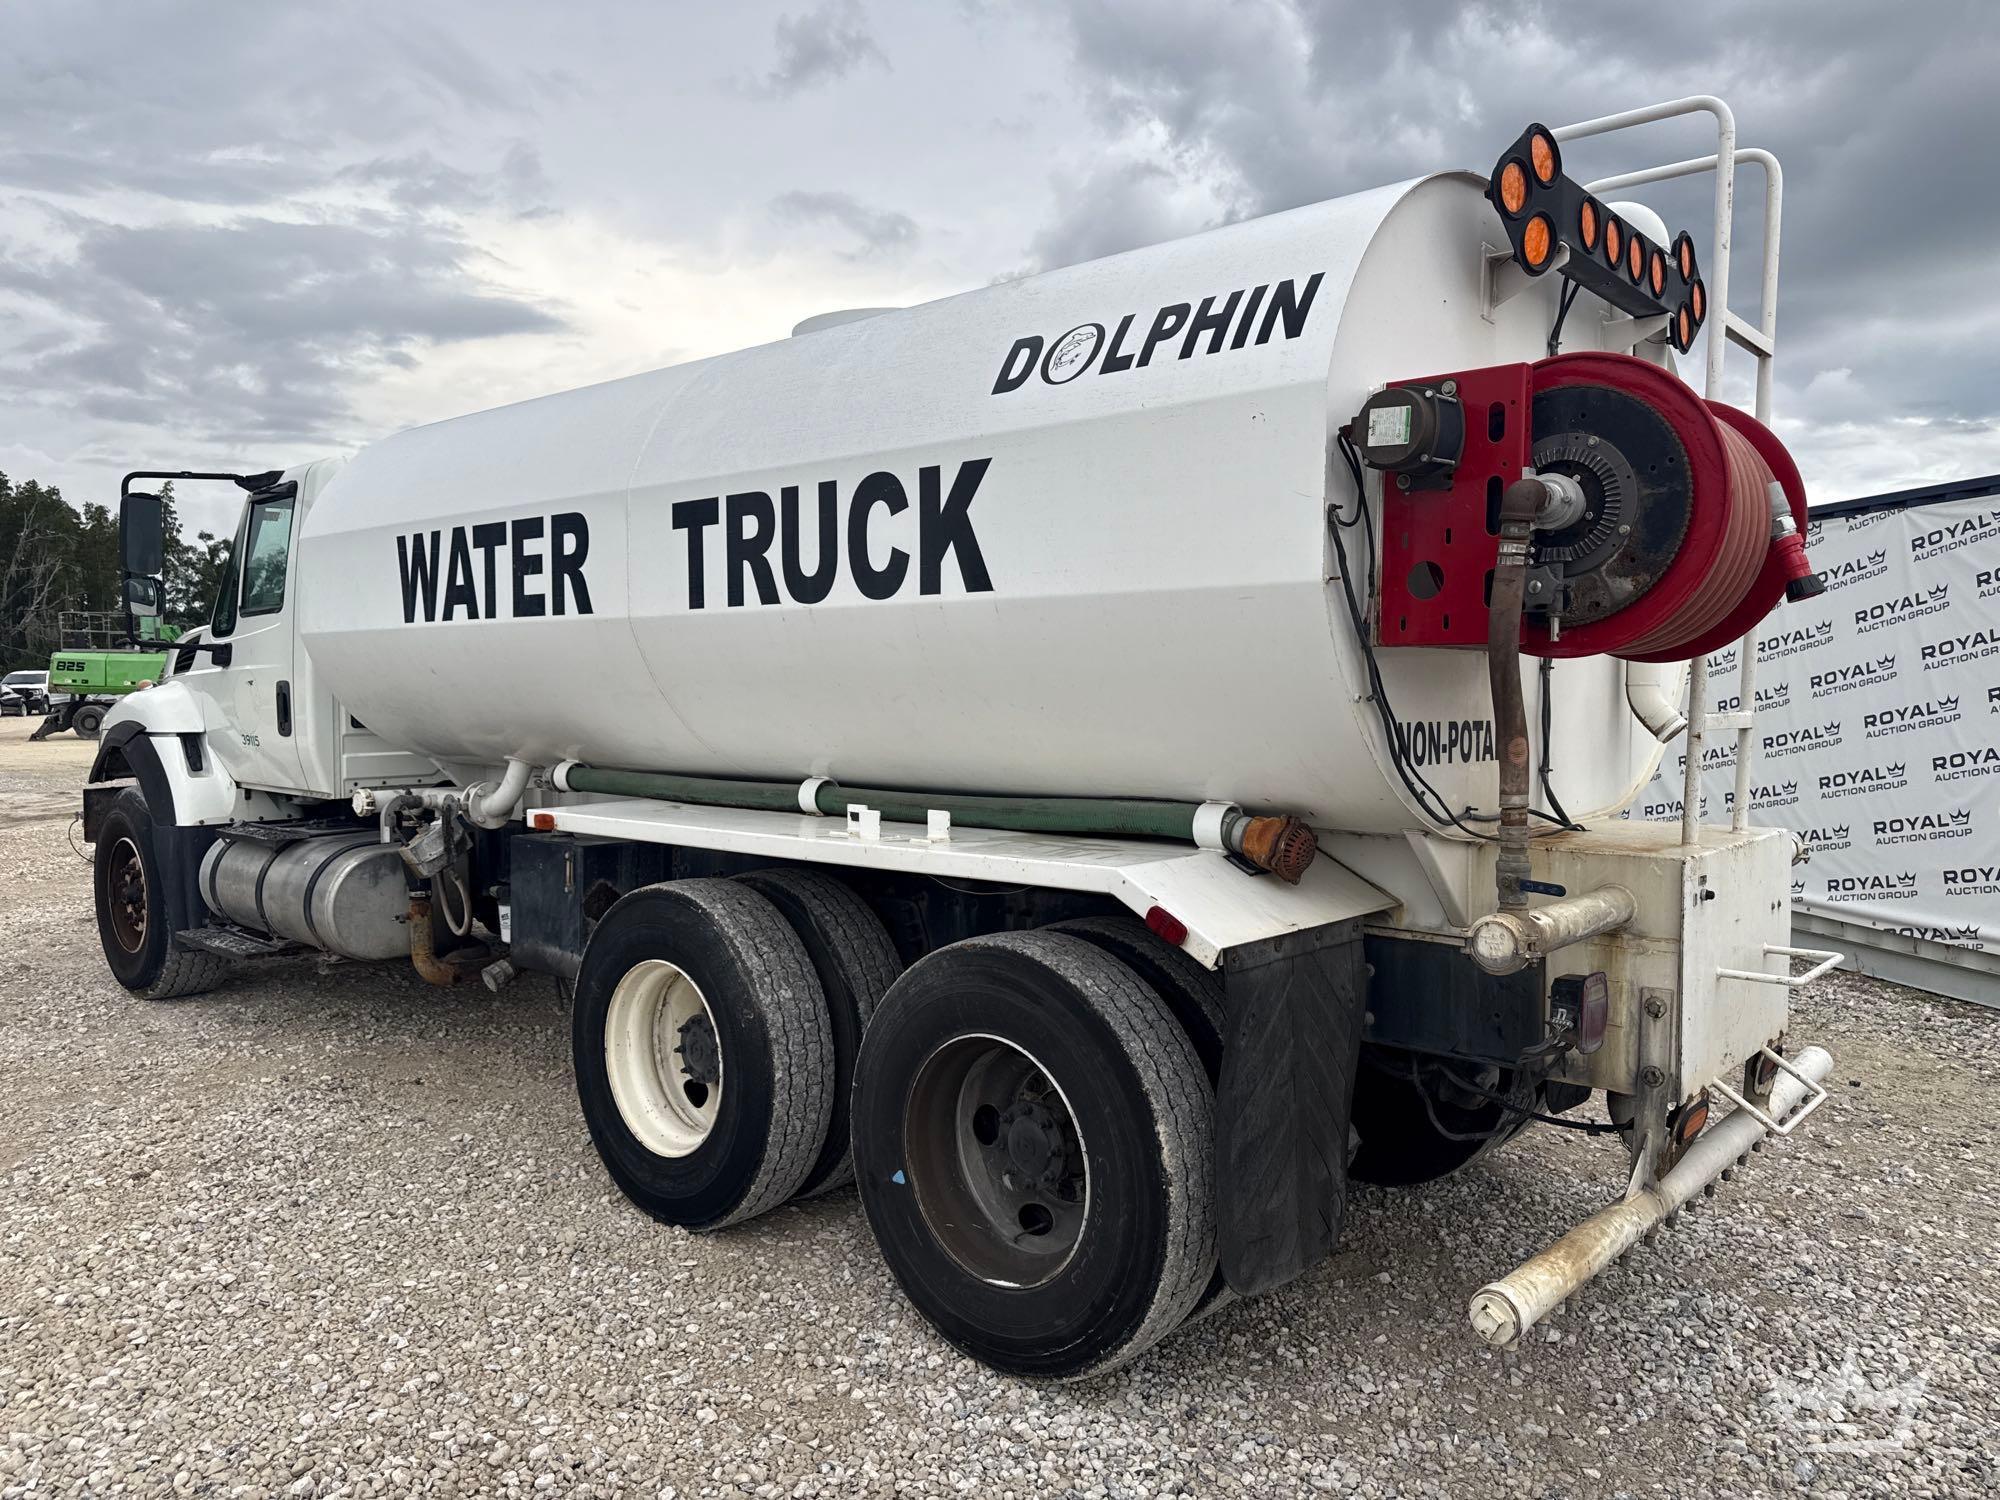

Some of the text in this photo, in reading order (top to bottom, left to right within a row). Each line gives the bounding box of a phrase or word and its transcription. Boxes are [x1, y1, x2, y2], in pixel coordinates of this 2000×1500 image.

[991, 271, 1326, 395] DOLPHIN
[396, 457, 995, 624] WATER TRUCK
[1805, 536, 1825, 550] OUP
[1911, 514, 1992, 552] ROYAL
[1913, 526, 2000, 563] AUCTION GRO
[1818, 558, 1868, 584] OYAL
[1824, 565, 1888, 593] TION GROUP
[1855, 592, 1928, 625] ROYAL
[1857, 601, 1950, 635] AUCTION GROUP
[1756, 635, 1834, 664] AUCTION GROUP
[1757, 627, 1816, 654] ROYAL
[1921, 628, 2000, 661] ROYAL
[56, 661, 86, 672] 825
[1708, 664, 1738, 678] GROUP
[1923, 650, 1979, 672] AUCTION
[1810, 661, 1877, 689] ROYAL
[1812, 671, 1898, 699] AUCTION GROUP
[1758, 698, 1790, 712] GROUP
[1863, 702, 1939, 729] ROYAL
[1865, 713, 1962, 739] AUCTION GROUP
[1398, 720, 1498, 767] NON-POTA
[1763, 726, 1824, 750] ROYAL
[1764, 737, 1843, 760] AUCTION GROUP
[1715, 759, 1737, 769] GRO
[1932, 747, 2000, 771] ROYA
[1819, 767, 1887, 790] ROYAL
[1934, 766, 1990, 783] AUCTION
[1820, 779, 1908, 800] AUCTION GROUP
[1644, 800, 1684, 816] ROYA
[1766, 796, 1799, 808] GROUP
[1797, 828, 1833, 843] YAL
[1873, 813, 1950, 835] ROYAL
[1816, 841, 1851, 852] GROUP
[1875, 828, 1973, 846] AUCTION GROUP
[1827, 875, 1897, 892] ROYAL
[1943, 867, 2000, 885] ROY
[1827, 890, 1918, 902] AUCTION GROUP
